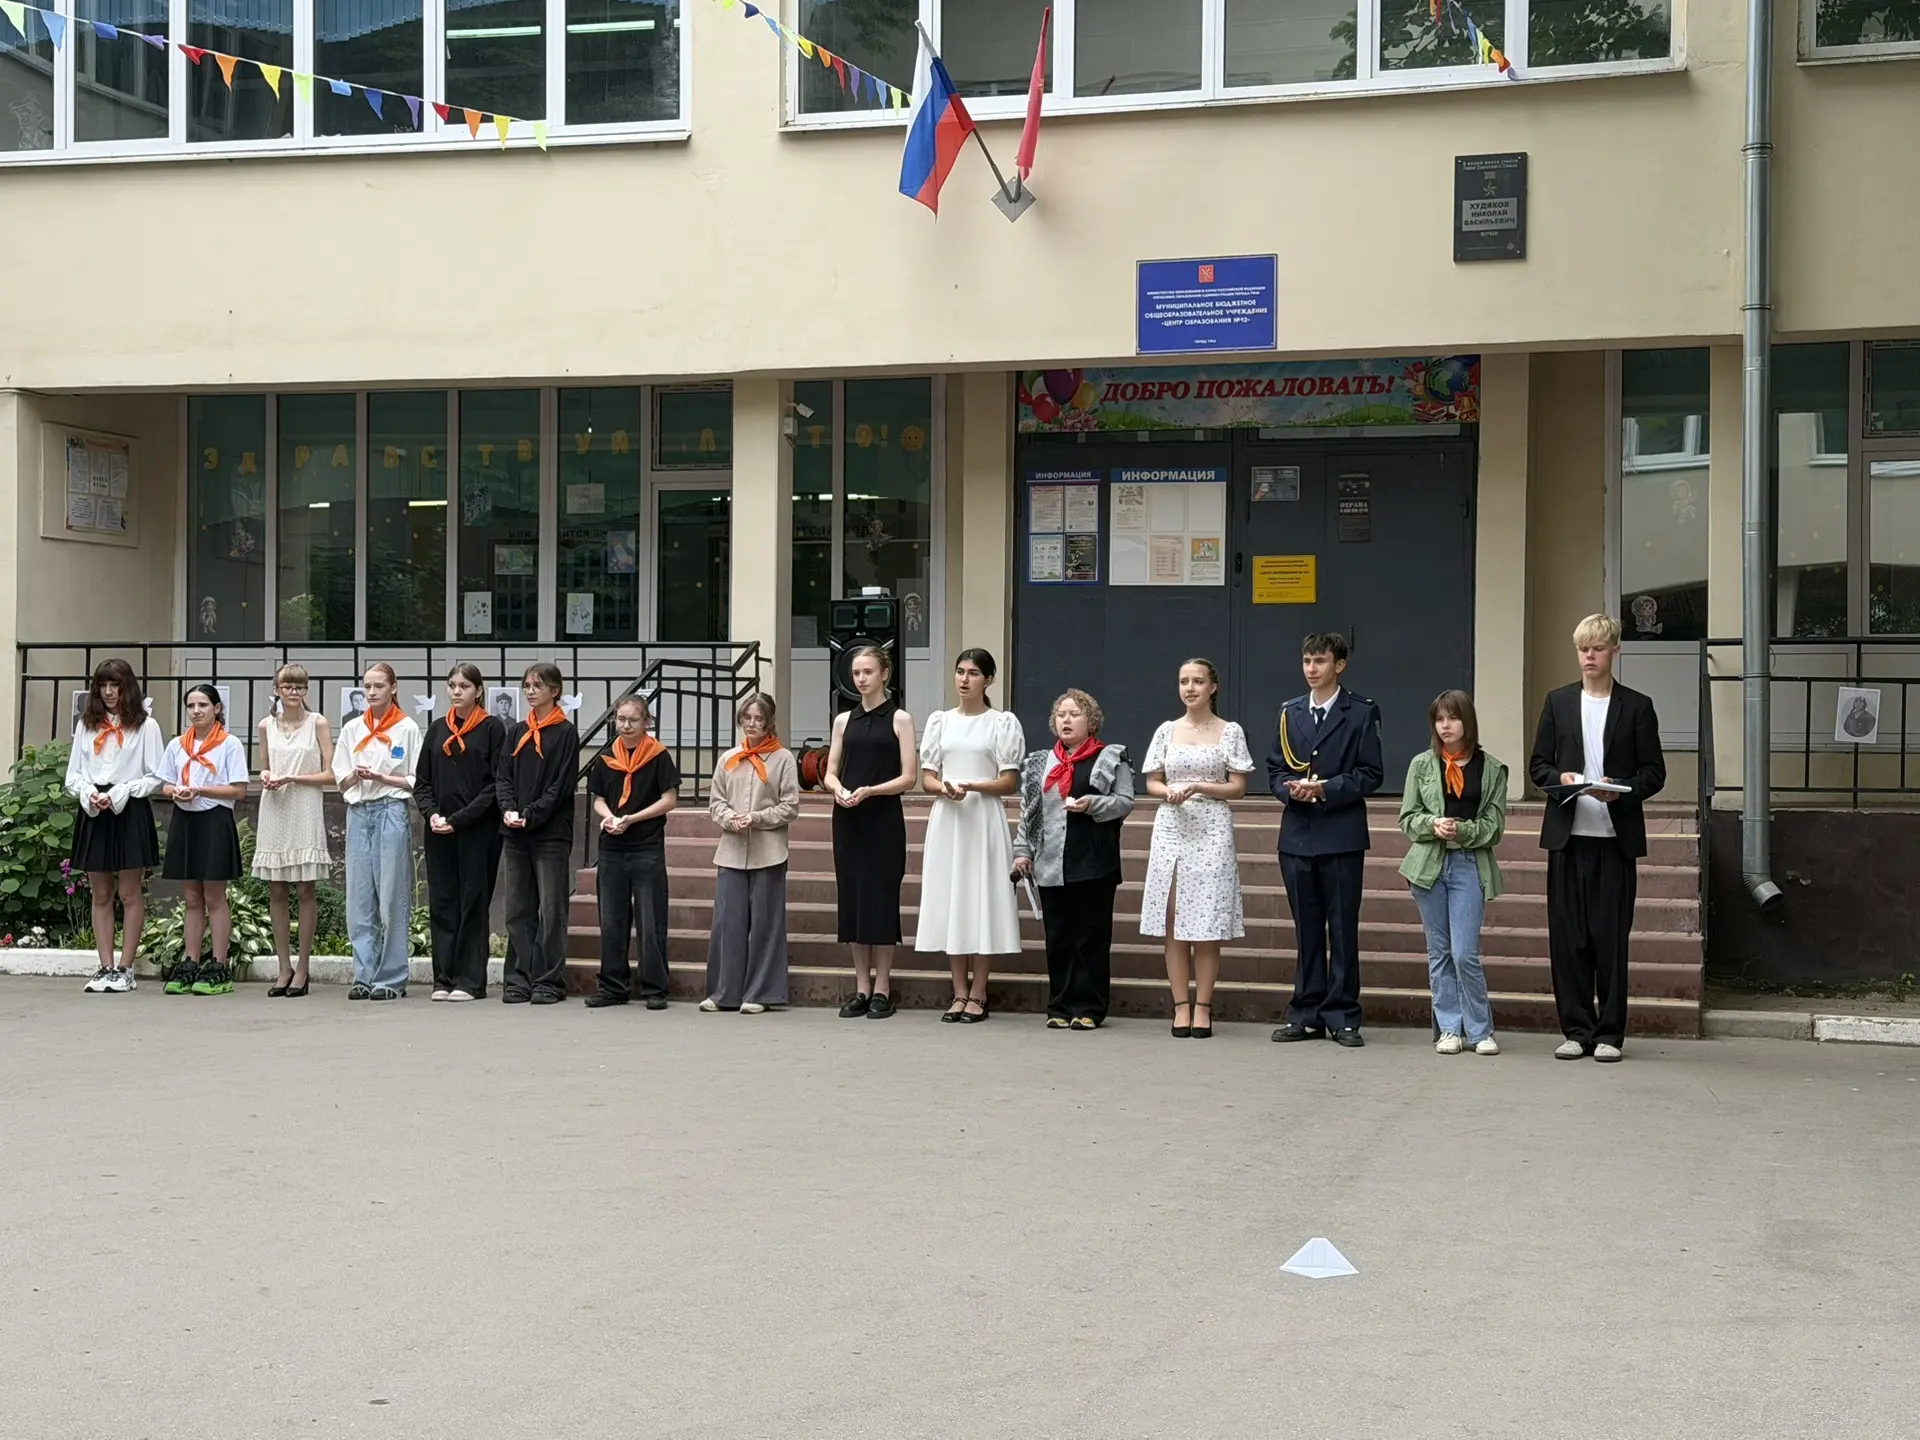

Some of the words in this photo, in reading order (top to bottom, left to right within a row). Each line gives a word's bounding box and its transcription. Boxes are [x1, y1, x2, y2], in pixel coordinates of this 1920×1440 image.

[1469, 202, 1510, 210] ХУДЯКОВ
[1156, 302, 1214, 310] МУНИЦИПАЛЬНОЕ
[1144, 309, 1224, 319] ОБЩЕОБРАЗОВАТЕЛЬНОЕ
[1226, 307, 1268, 315] УЧРЕЖДЕНИЕ
[1185, 317, 1231, 325] ОБРАЗОВАНИЯ
[1100, 379, 1190, 402] ДОБРО
[1193, 375, 1395, 399] ПОЖАЛОВАТЬ!
[1036, 471, 1092, 479] ИНФОРМАЦИЯ
[1122, 471, 1216, 482] ИНФОРМАЦИЯ
